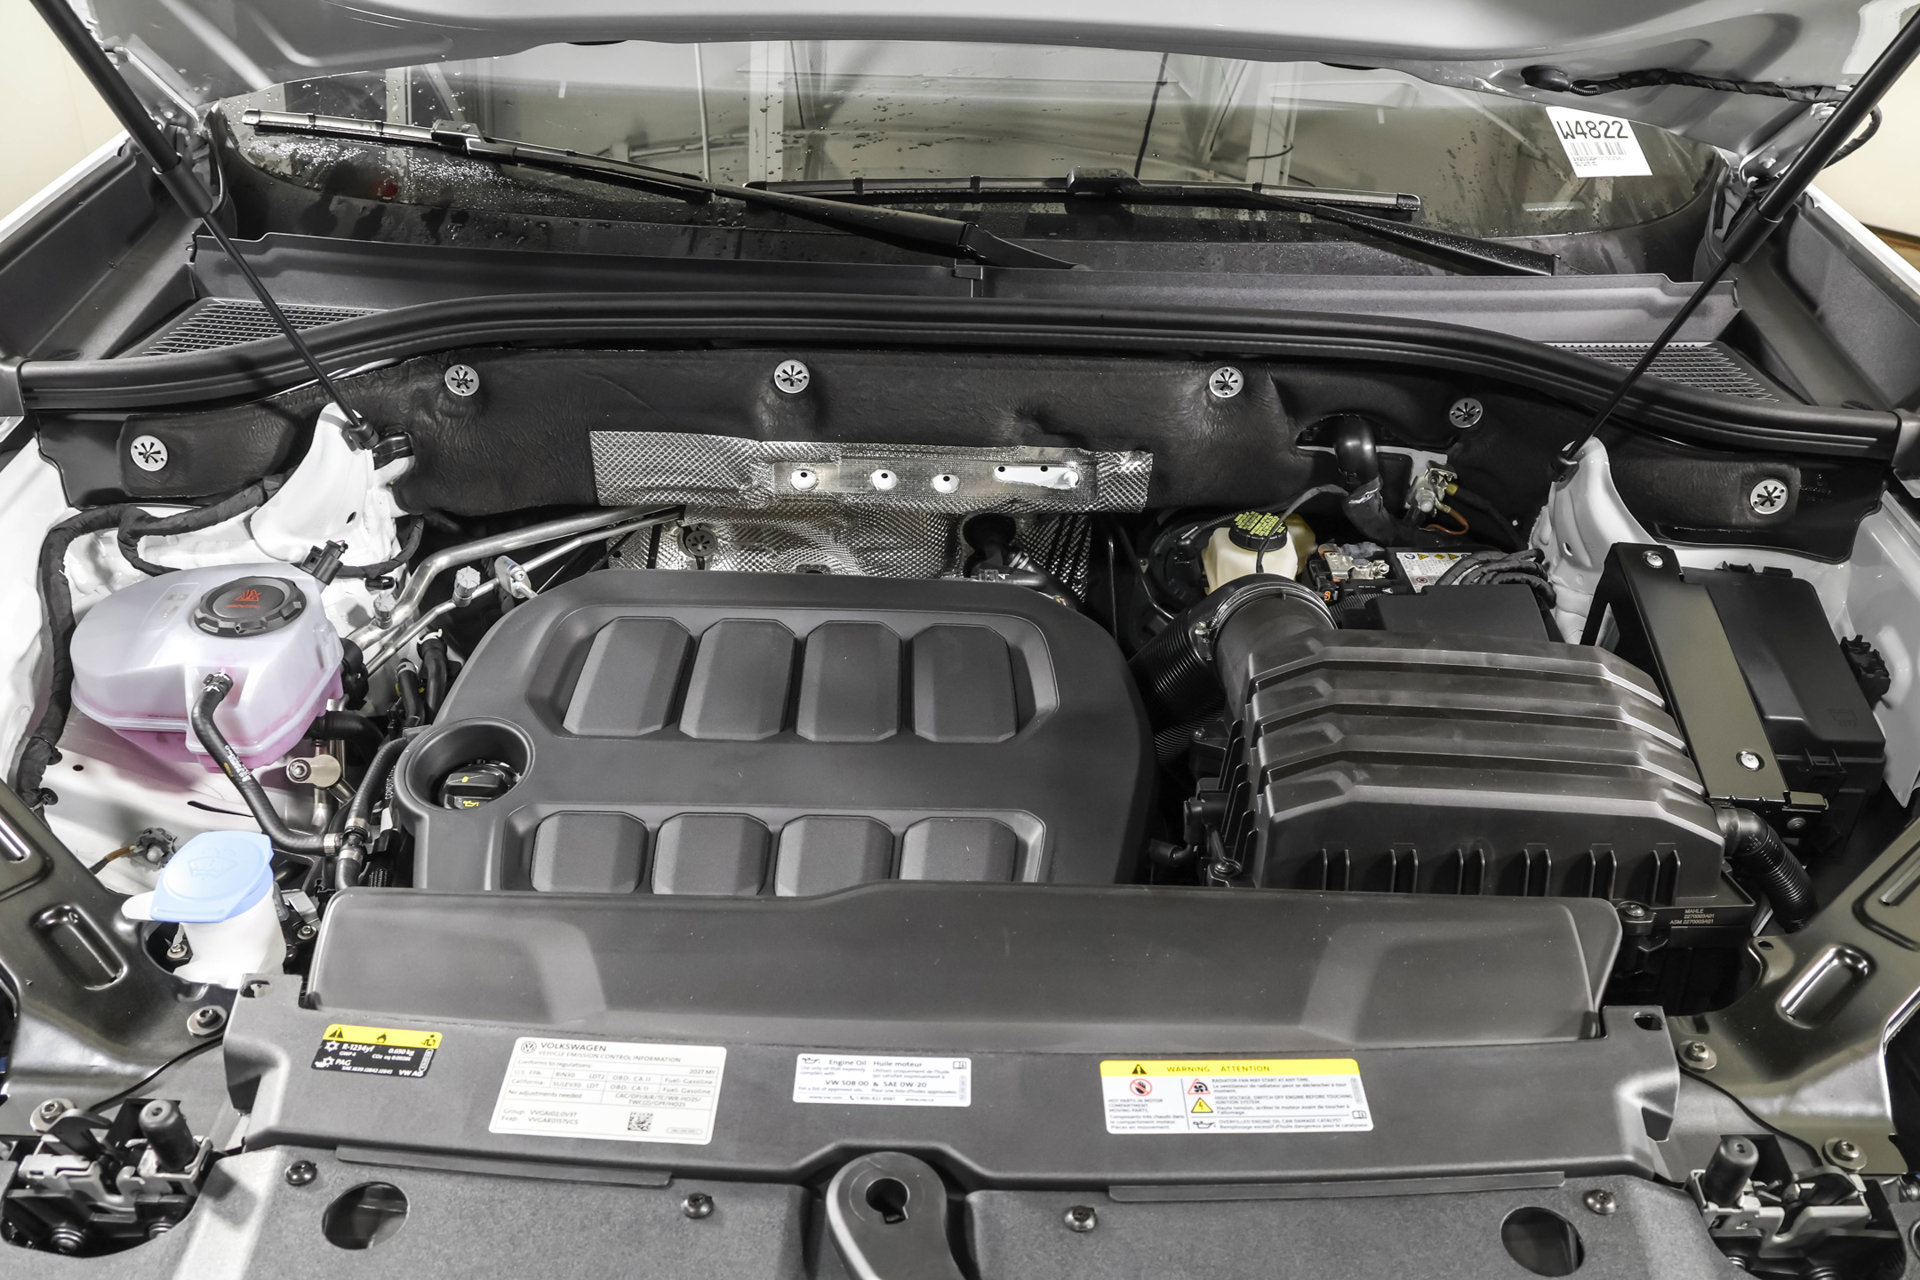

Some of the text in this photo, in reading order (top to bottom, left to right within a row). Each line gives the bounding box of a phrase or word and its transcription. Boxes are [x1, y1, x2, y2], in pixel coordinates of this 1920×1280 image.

[1556, 120, 1629, 140] W4822
[341, 1043, 375, 1053] R-1234yf
[540, 1042, 608, 1052] VOLKSWAGEN
